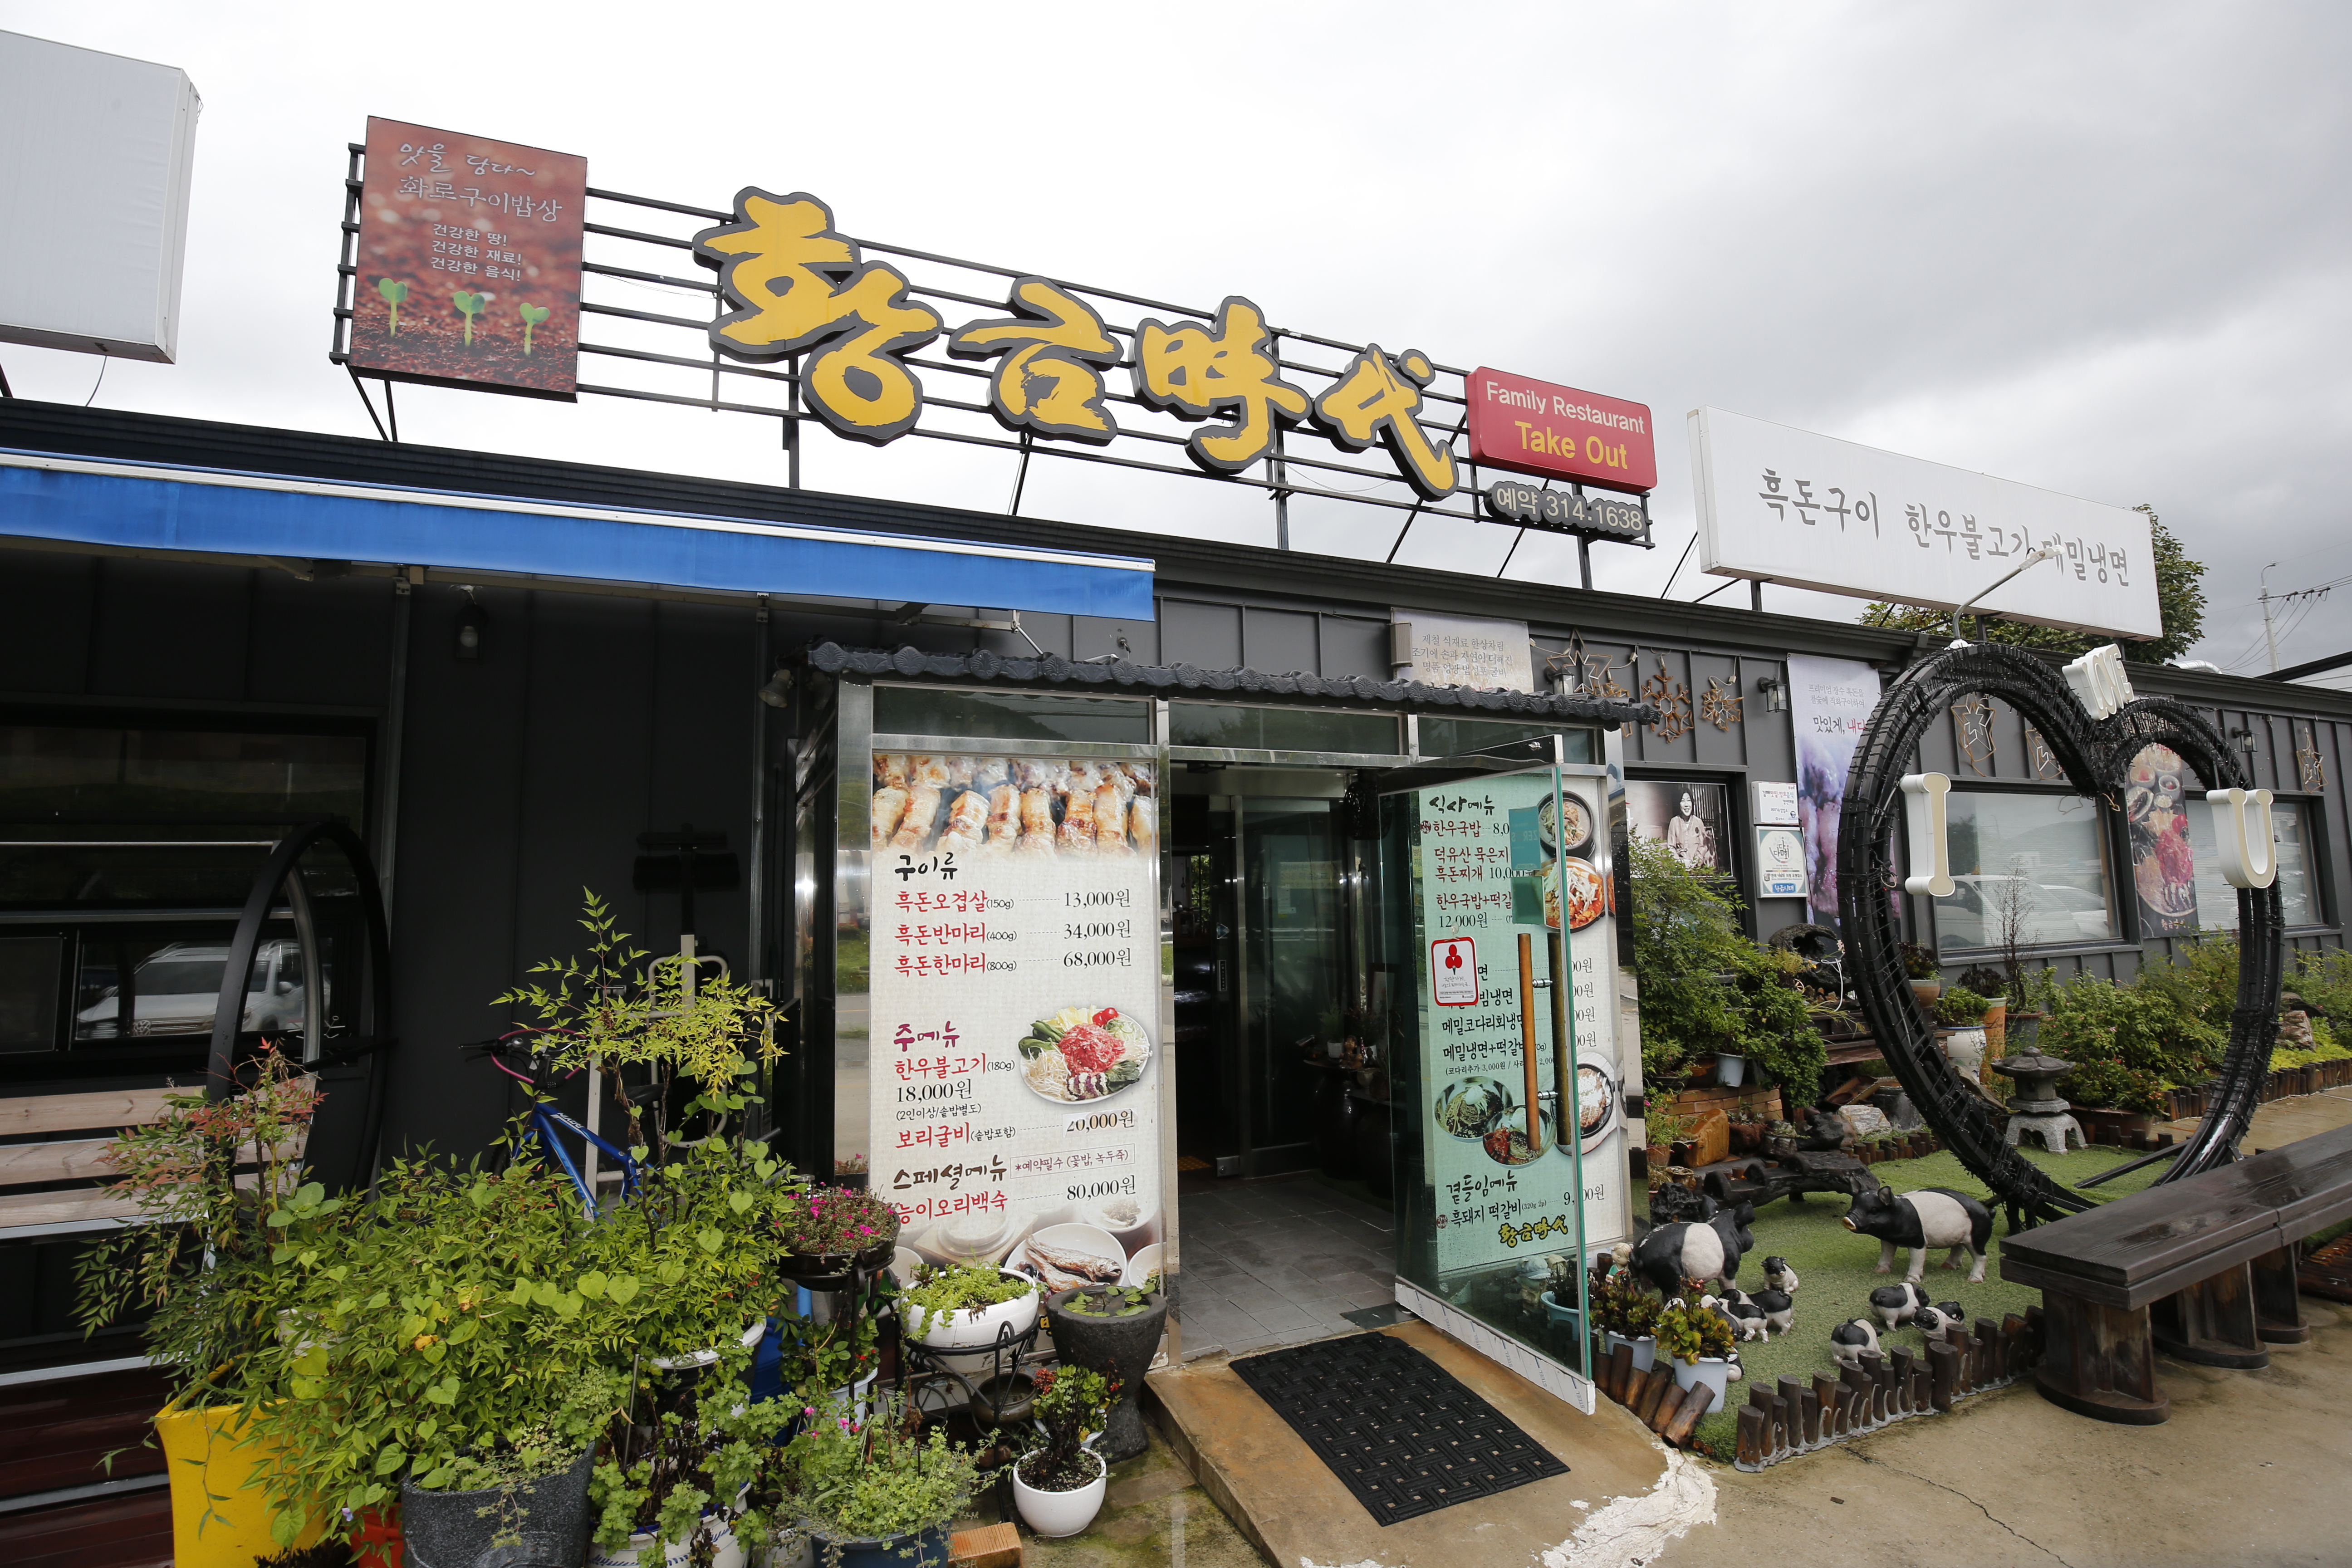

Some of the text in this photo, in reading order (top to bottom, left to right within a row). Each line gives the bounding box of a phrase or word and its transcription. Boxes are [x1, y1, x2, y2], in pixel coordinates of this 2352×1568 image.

[399, 176, 563, 222] 화로구이밥상
[433, 224, 507, 246] 건강한 땅!
[431, 240, 521, 265] 건강한 재료!
[431, 257, 520, 282] 건강한 음식!
[1486, 380, 1645, 434] Family Restaurant
[1514, 420, 1628, 470] Take Out
[1497, 488, 1539, 515] 예약
[1759, 467, 1880, 540] 흑돈구이
[1904, 502, 2030, 560] 한우불고기
[1422, 634, 1504, 652] 제철 식재료 한상차림
[1412, 647, 1513, 666] 조기에 손과 자연이 더해진
[1422, 661, 1440, 673] 명품
[1490, 667, 1507, 678] 굴비
[1808, 684, 1864, 698] 프리미엄 장수 흑돈을
[1811, 695, 1865, 708] 참숯에 직화구이하여
[1813, 715, 1845, 735] 맛있게,
[2072, 643, 2134, 720] LOVE
[2217, 788, 2277, 889] U
[1429, 795, 1495, 816] 식사메뉴
[1433, 819, 1481, 838] 한우국밥
[1434, 846, 1471, 864] 덕유산
[1474, 846, 1509, 864] 묵은지
[894, 852, 958, 881] 구이류
[1435, 865, 1483, 883] 흑돈찌개
[1064, 888, 1131, 908] 13,000원
[1436, 891, 1512, 911] 한우국밥+떡갈
[1063, 919, 1132, 940] 34,000원
[1063, 947, 1132, 968] 68,000원
[893, 1021, 960, 1052] 주메뉴
[1446, 1063, 1480, 1076] (코다리추가
[1482, 1061, 1506, 1072] 3,000원
[896, 1078, 972, 1103] 18,000원
[896, 1103, 981, 1121] (2인이상/솥밥별도)
[893, 1154, 1007, 1190] 스페셜메뉴
[1095, 1149, 1128, 1164] 녹두죽)
[1446, 1170, 1518, 1205] 곁들임메뉴
[896, 1175, 1136, 1224] 능이오리백숙 80,000원
[1451, 1205, 1485, 1228] 흑돼지
[1473, 1334, 1481, 1349] STEEL
[1504, 1351, 1513, 1367] STEEL
[1539, 1369, 1548, 1387] STEEL
[1576, 1391, 1585, 1409] STEEL
